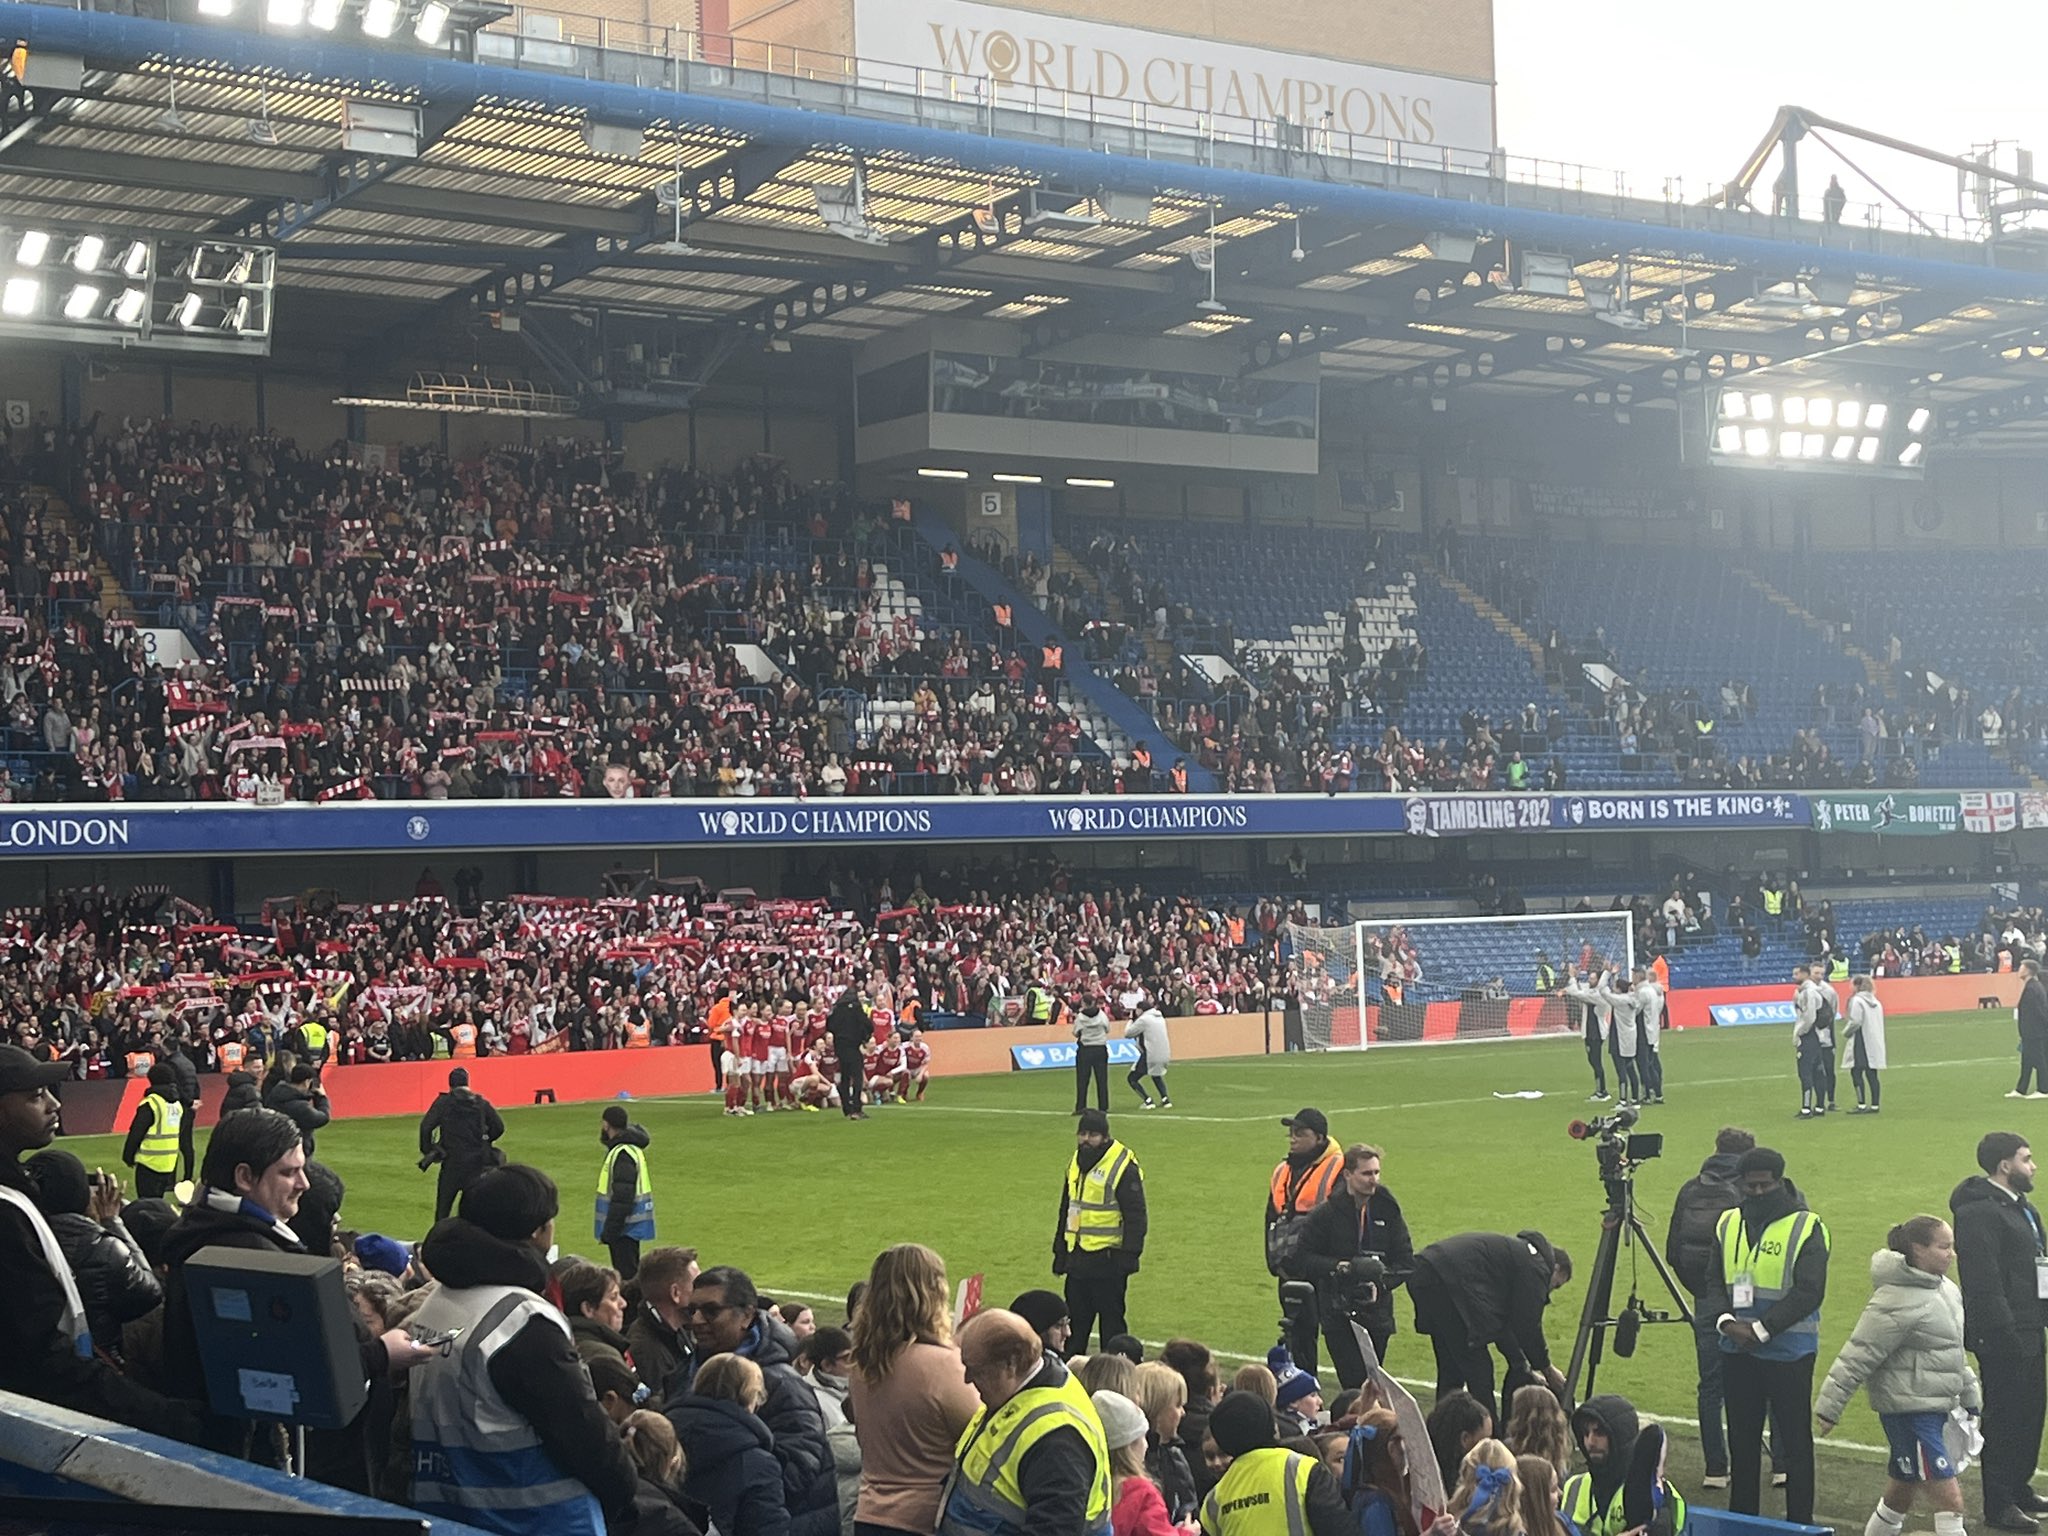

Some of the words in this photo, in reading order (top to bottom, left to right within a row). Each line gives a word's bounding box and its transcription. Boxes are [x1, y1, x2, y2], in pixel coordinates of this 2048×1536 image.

[1142, 57, 1436, 145] CHAMPIONS
[10, 404, 24, 426] 3
[983, 494, 998, 514] 5
[143, 632, 157, 654] 3
[1048, 807, 1125, 832] WORLD
[1130, 805, 1248, 830] CHAMPIONS
[1429, 799, 1516, 830] TAMBLING
[1518, 797, 1551, 829] 202
[1588, 797, 1644, 820] BORN
[1650, 797, 1669, 819] IS
[1672, 797, 1713, 818] THE
[1717, 795, 1765, 816] KING
[1834, 803, 1870, 822] PETER
[1909, 804, 1956, 824] BONETTI
[698, 810, 788, 836] WORLD
[791, 809, 932, 835] CHAMPIONS
[1759, 1240, 1782, 1256] 420
